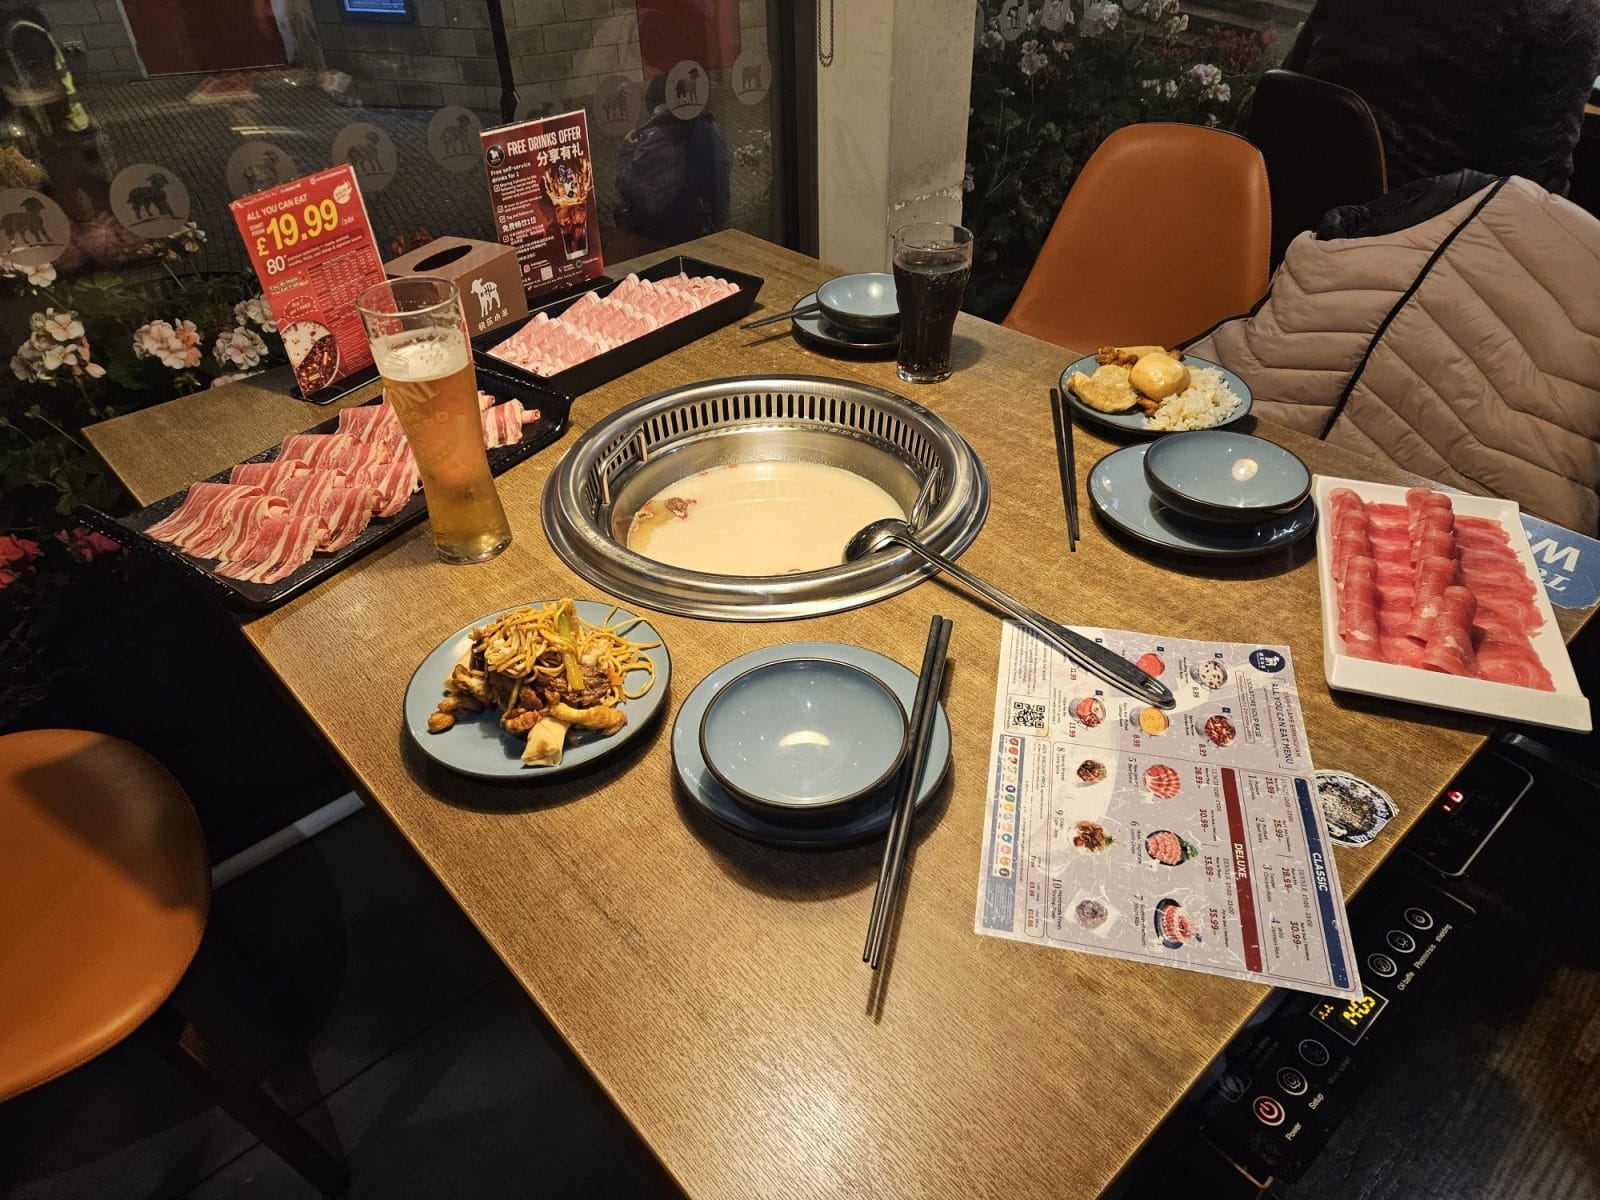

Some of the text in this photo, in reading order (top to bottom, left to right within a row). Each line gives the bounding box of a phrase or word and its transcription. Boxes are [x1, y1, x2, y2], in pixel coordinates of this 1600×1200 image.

[507, 126, 581, 157] FREE DRINKS OFFER
[536, 142, 584, 167] 分享有礼
[247, 193, 308, 222] ALL YOU CAN EAT
[1270, 682, 1293, 764] ALL YOU CAN EAT MENU
[1204, 855, 1213, 876] 33.99
[1233, 842, 1247, 879] DELUXE
[1311, 852, 1328, 892] CLASSIC
[1052, 878, 1061, 889] 10
[1209, 907, 1219, 930] 35.99
[1289, 920, 1302, 945] 30.99
[1308, 1093, 1324, 1110] Setup
[1285, 1122, 1301, 1141] Power
